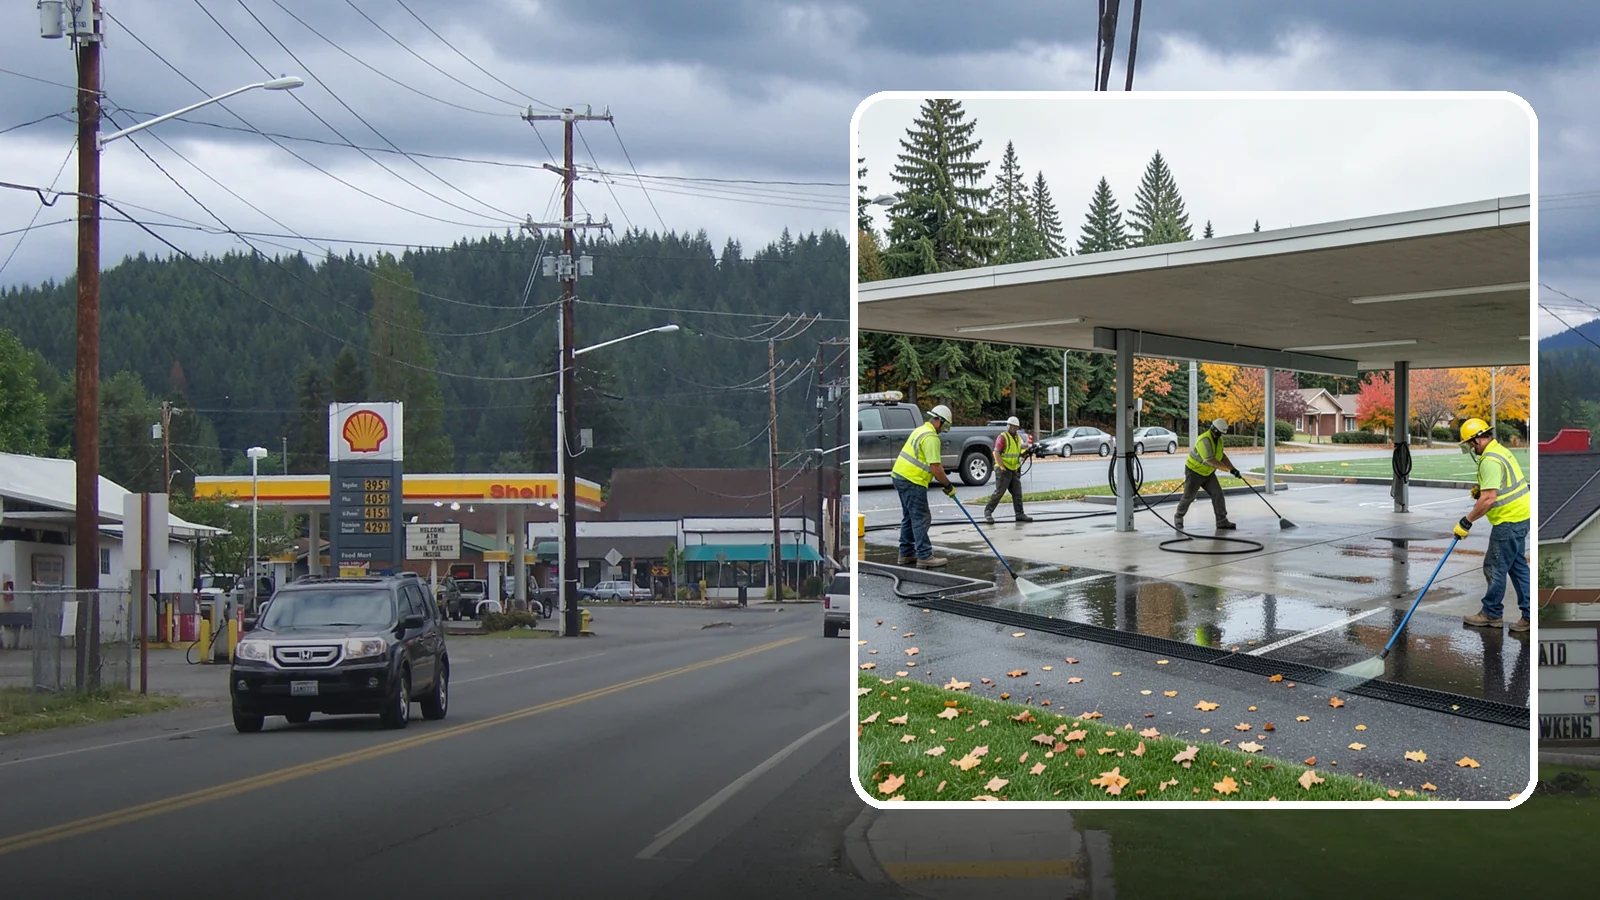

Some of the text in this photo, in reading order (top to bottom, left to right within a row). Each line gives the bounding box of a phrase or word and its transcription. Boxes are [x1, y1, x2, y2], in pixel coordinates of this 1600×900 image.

[366, 480, 383, 490] 395
[490, 485, 547, 499] Shell
[366, 494, 383, 504] 405
[366, 508, 383, 518] 415
[366, 522, 383, 532] 429
[1538, 643, 1567, 665] AID
